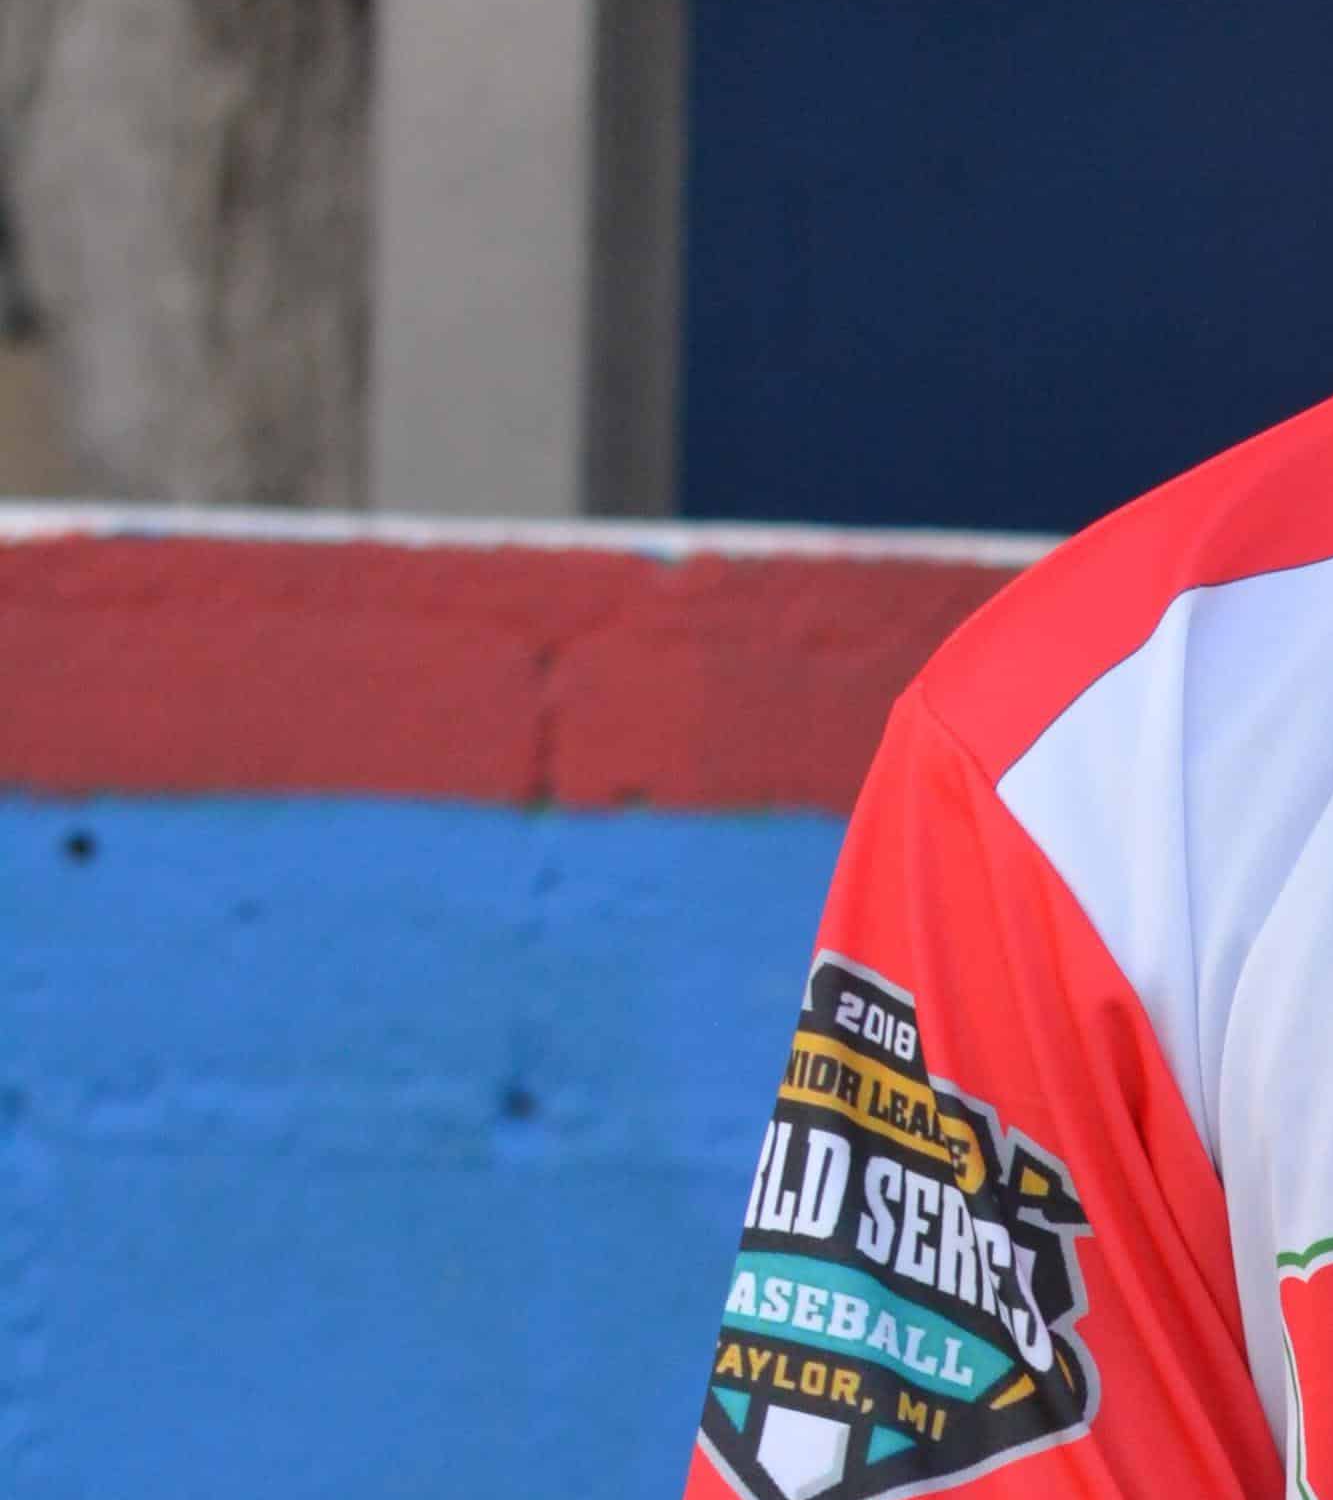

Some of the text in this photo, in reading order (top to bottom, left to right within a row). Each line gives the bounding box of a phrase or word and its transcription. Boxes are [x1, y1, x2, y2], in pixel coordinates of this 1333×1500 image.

[834, 991, 918, 1062] 2018
[724, 1270, 974, 1388] ASEBALL
[714, 1342, 948, 1442] AYLOR, MI
